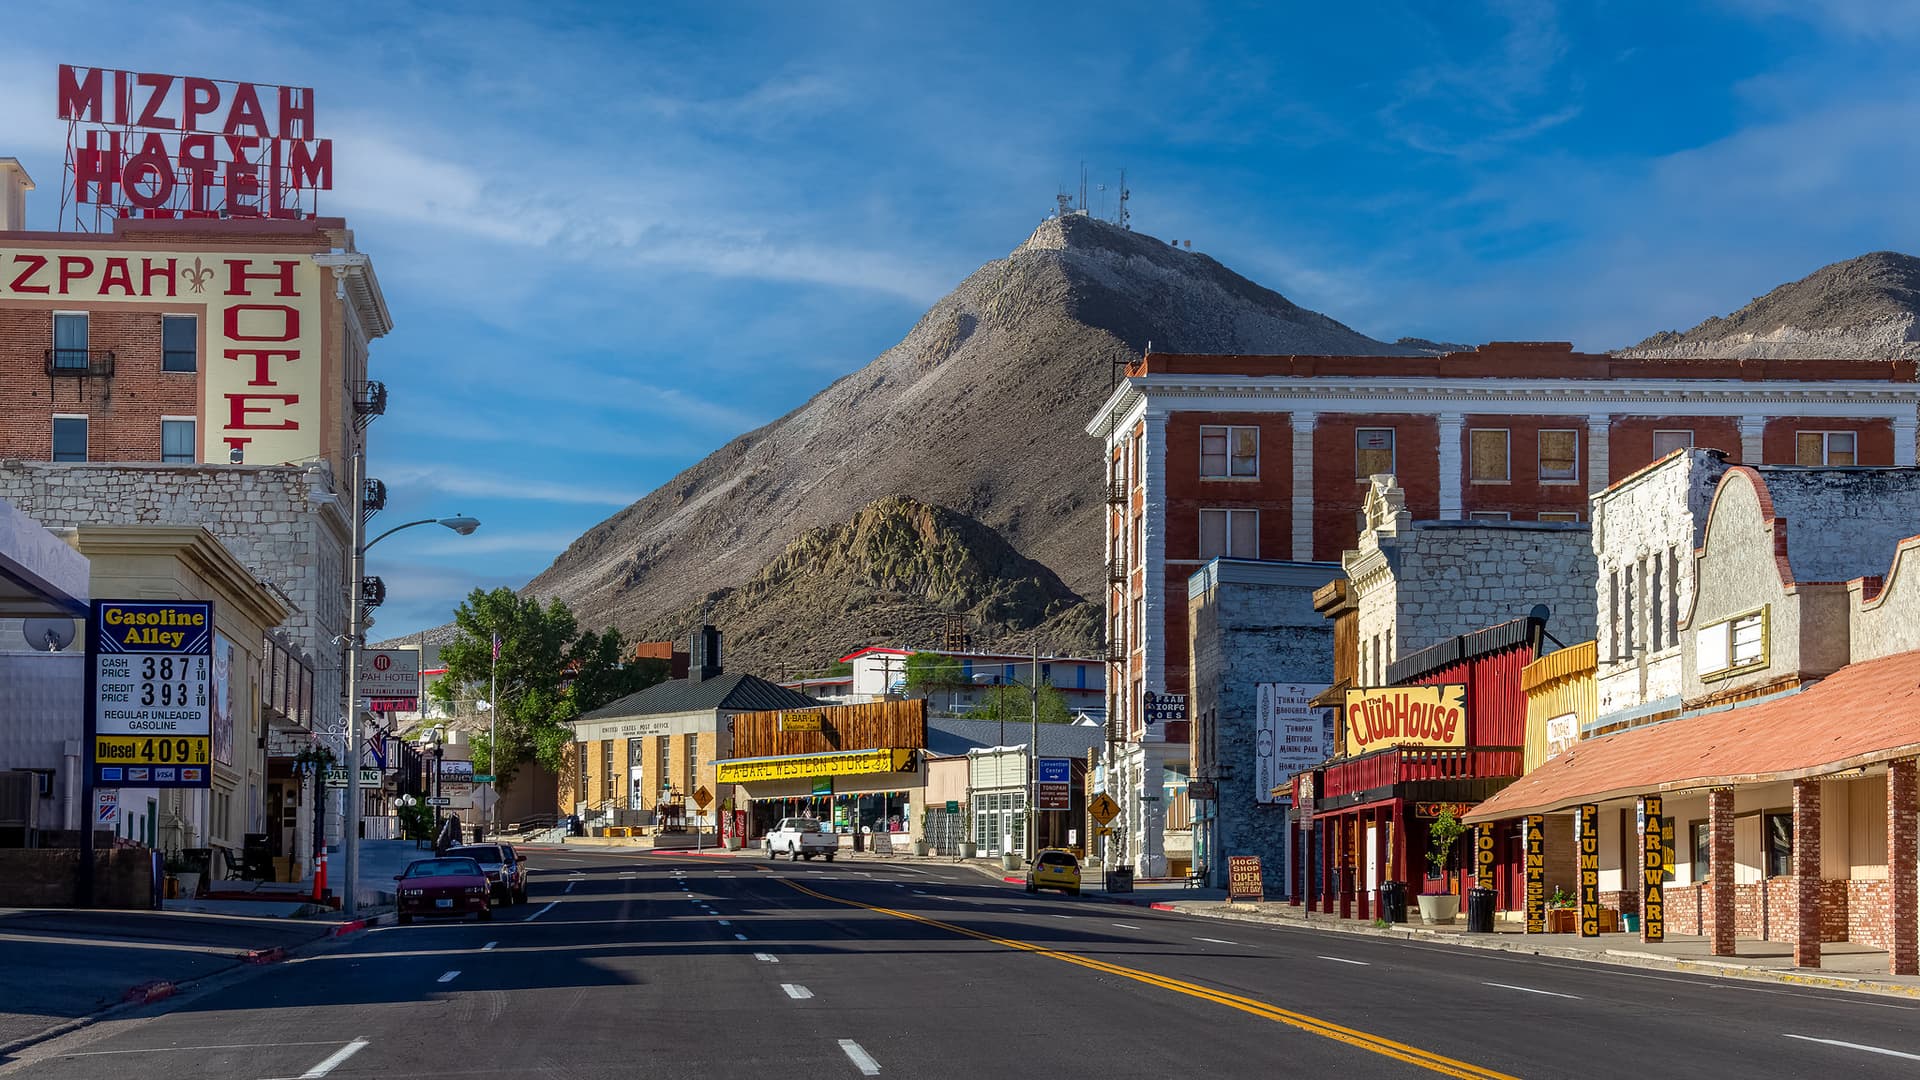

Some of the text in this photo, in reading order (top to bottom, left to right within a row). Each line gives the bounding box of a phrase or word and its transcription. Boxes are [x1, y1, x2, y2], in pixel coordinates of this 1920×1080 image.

[58, 64, 315, 142] MIZPAH
[75, 147, 303, 219] HOTEL
[0, 254, 178, 296] ZPAH
[105, 608, 205, 626] Gasoline
[123, 627, 185, 648] Alley
[102, 658, 128, 667] CASH
[142, 657, 189, 681] 387
[102, 669, 130, 678] PRICE
[384, 673, 417, 681] HOTEL
[102, 684, 135, 693] CREDIT
[102, 694, 129, 702] PRICE
[141, 682, 188, 706] 393
[1366, 697, 1382, 706] The
[104, 711, 201, 720] REGULAR UNLEADED
[129, 721, 177, 730] GASOLINE
[1349, 693, 1459, 746] ClubHouse
[98, 739, 189, 762] Diesel 409
[156, 771, 174, 779] VISA
[327, 770, 378, 780] PARING
[775, 757, 828, 776] WESTERN
[831, 754, 870, 771] STORE
[1479, 823, 1494, 890] TOOLS
[1233, 872, 1260, 881] OPEN
[1527, 816, 1544, 933] PAINT SUPPLIES
[1582, 805, 1599, 935] PLUMBING
[1645, 799, 1664, 938] HARDWARE
